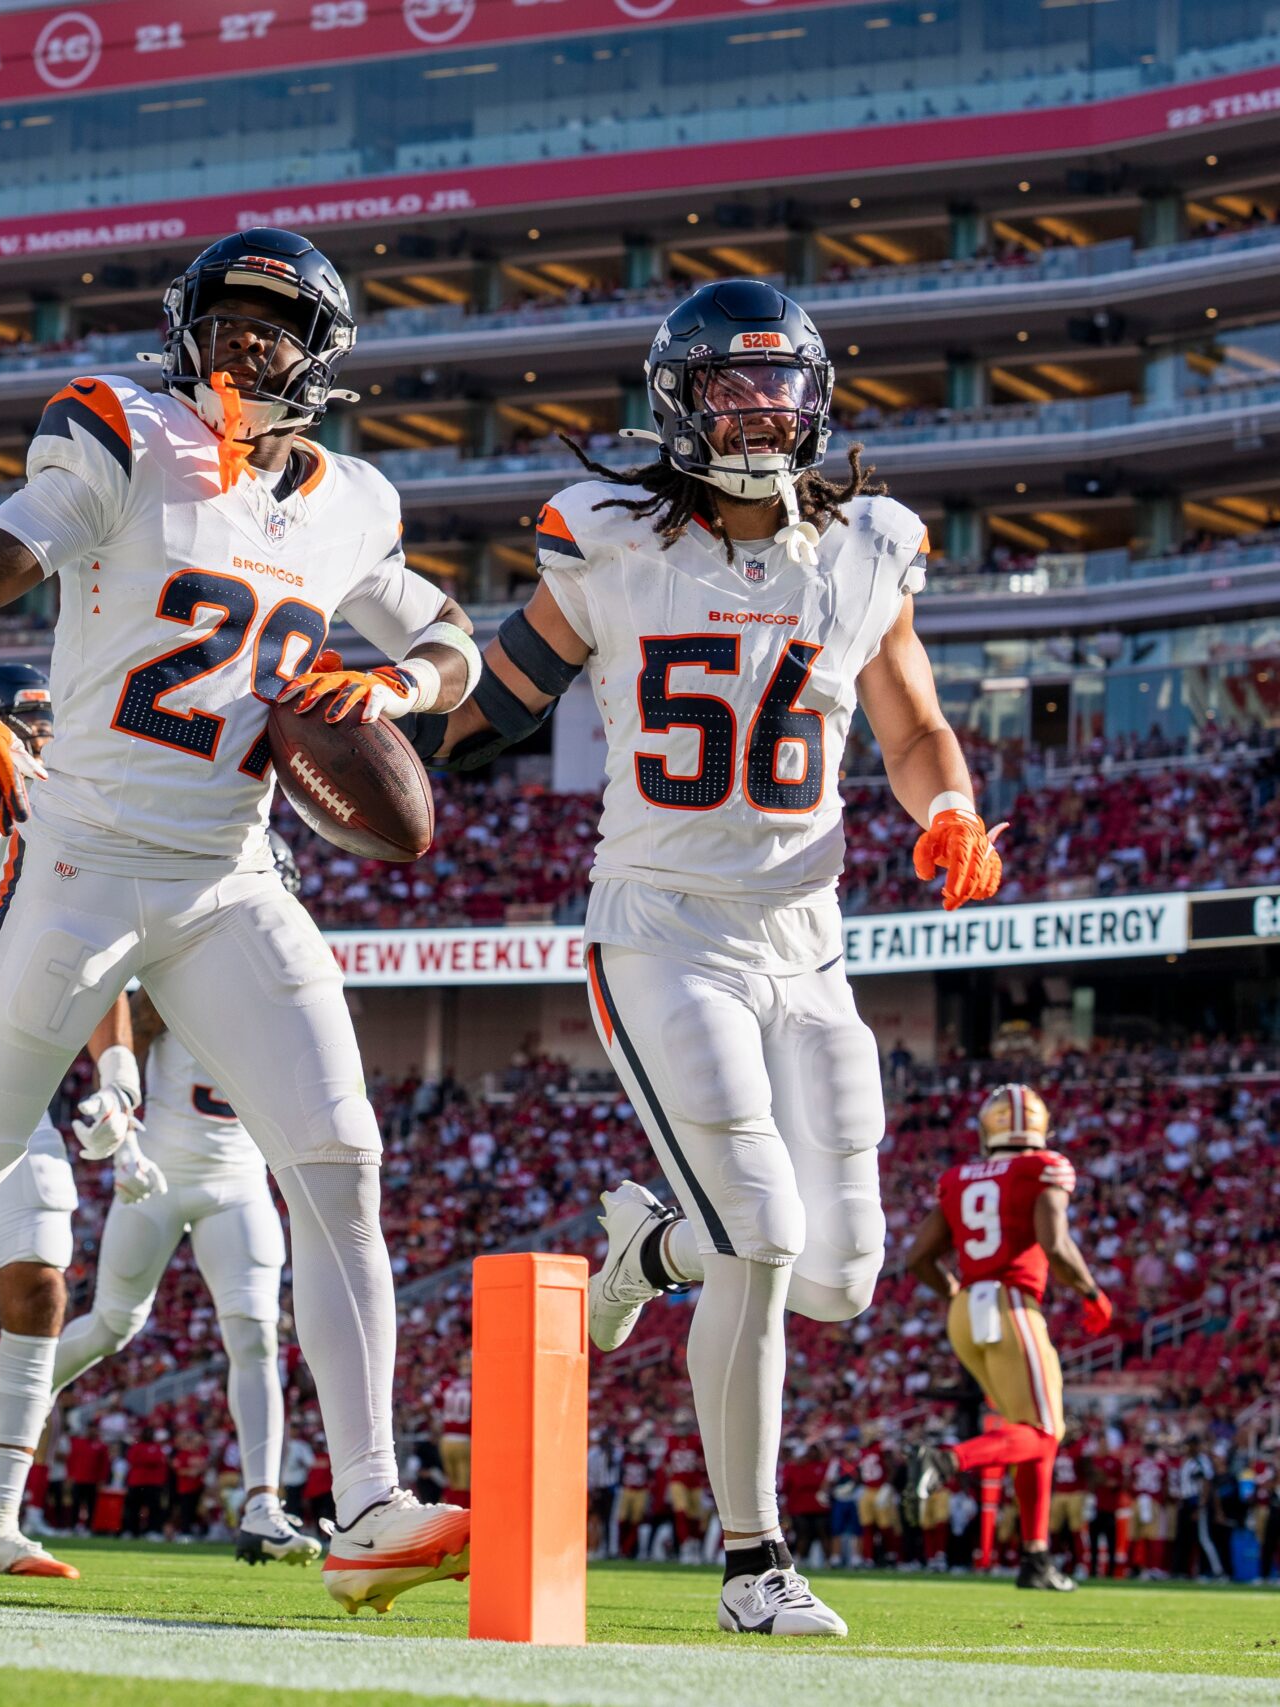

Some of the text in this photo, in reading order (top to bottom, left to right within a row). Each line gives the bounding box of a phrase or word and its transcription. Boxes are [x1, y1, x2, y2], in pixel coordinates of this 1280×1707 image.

[46, 34, 90, 64] 16
[134, 21, 185, 53] 21
[219, 9, 276, 42] 27
[310, 0, 367, 31] 33
[23, 218, 187, 252] MORABITO
[742, 333, 781, 348] 5280
[232, 556, 304, 587] BRONCOS
[745, 567, 765, 580] NFL
[708, 611, 799, 625] BRONCOS
[634, 634, 824, 814] 56
[871, 918, 1023, 960] FAITHFUL
[1033, 905, 1165, 948] ENERGY
[330, 943, 405, 974] NEW
[417, 938, 555, 972] WEEKLY
[960, 1179, 1001, 1261] 9
